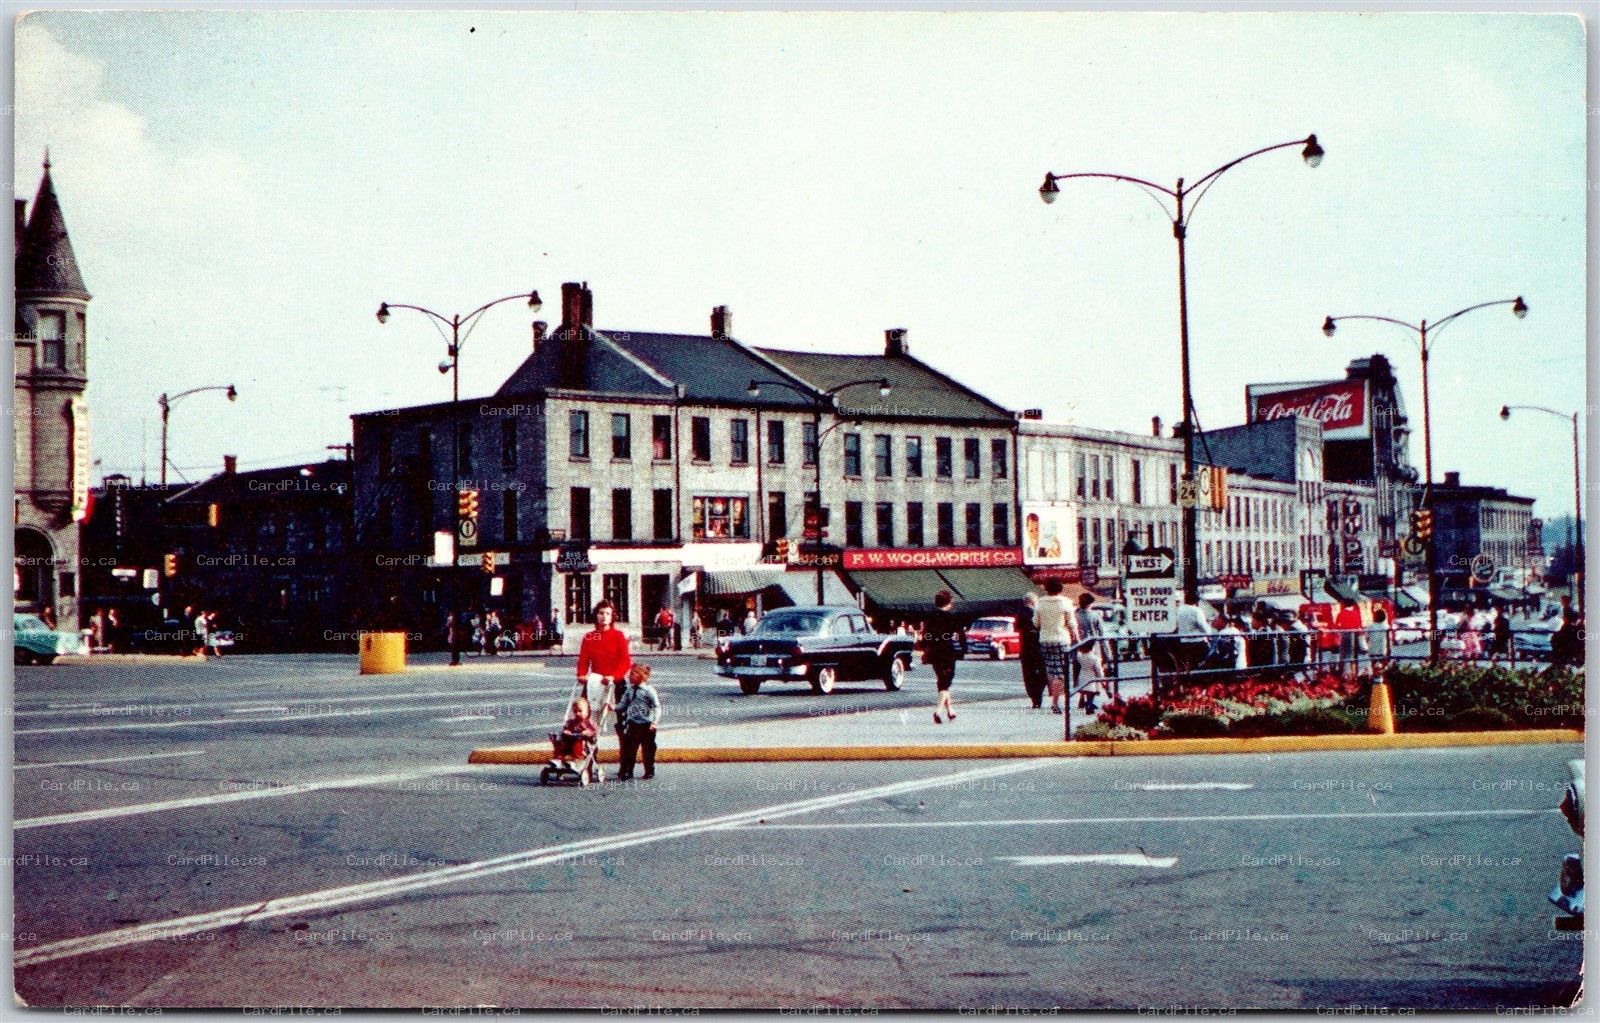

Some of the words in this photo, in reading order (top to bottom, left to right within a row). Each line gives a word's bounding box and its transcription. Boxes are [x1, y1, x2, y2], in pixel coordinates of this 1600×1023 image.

[1180, 487, 1197, 500] 24
[852, 554, 864, 565] F.
[868, 553, 884, 564] W.
[887, 551, 991, 564] WOOLWORTH
[1136, 557, 1162, 568] WEST
[1130, 587, 1147, 596] WEST
[1150, 587, 1173, 596] BOUND
[1134, 597, 1169, 607] TRAFFIC
[1132, 610, 1169, 621] ENTER
